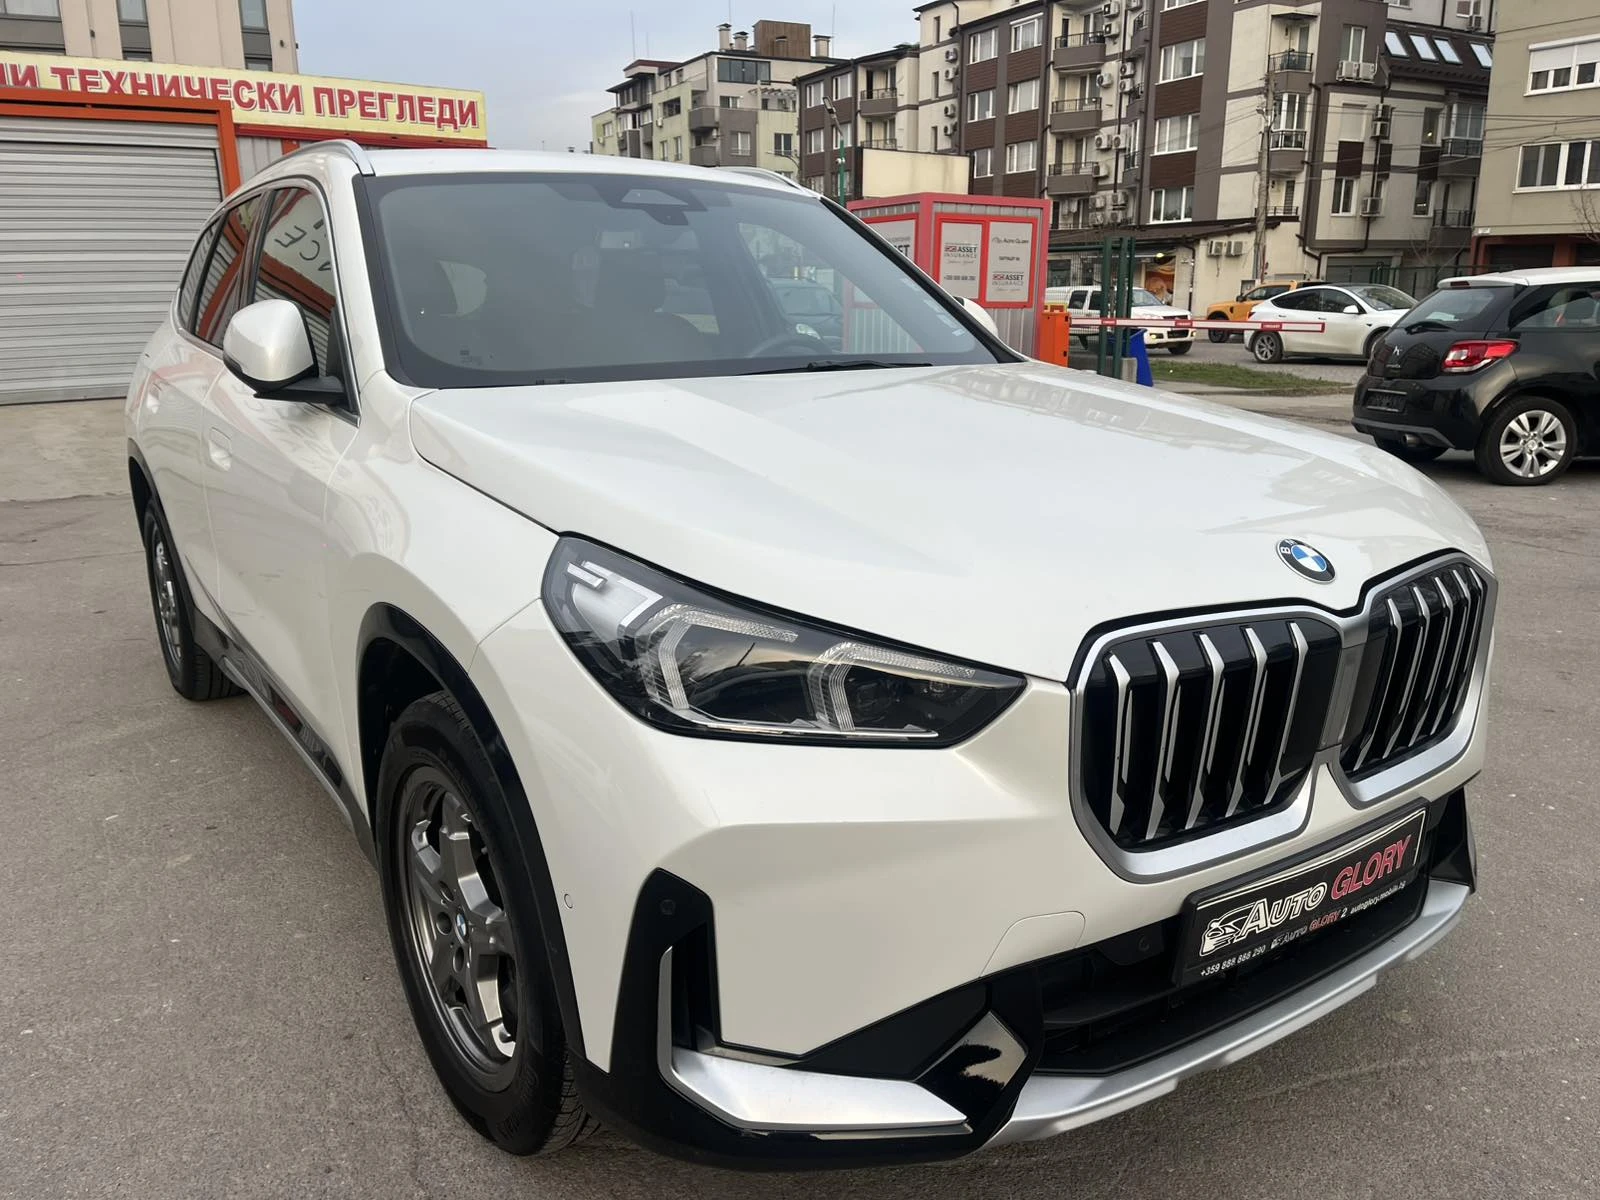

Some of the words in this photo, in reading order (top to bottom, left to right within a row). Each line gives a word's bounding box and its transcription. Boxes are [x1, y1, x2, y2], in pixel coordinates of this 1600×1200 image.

[50, 66, 303, 115] ТЕХНИЧЕСКИ
[313, 86, 479, 131] ПРЕГЛЕДИ
[1234, 882, 1328, 942] AUTO
[1331, 834, 1411, 900] GLORY
[1200, 962, 1221, 976] +359
[1221, 957, 1237, 969] 888
[1252, 945, 1266, 957] 290
[1309, 909, 1341, 931] GLORY
[1341, 907, 1348, 918] 2
